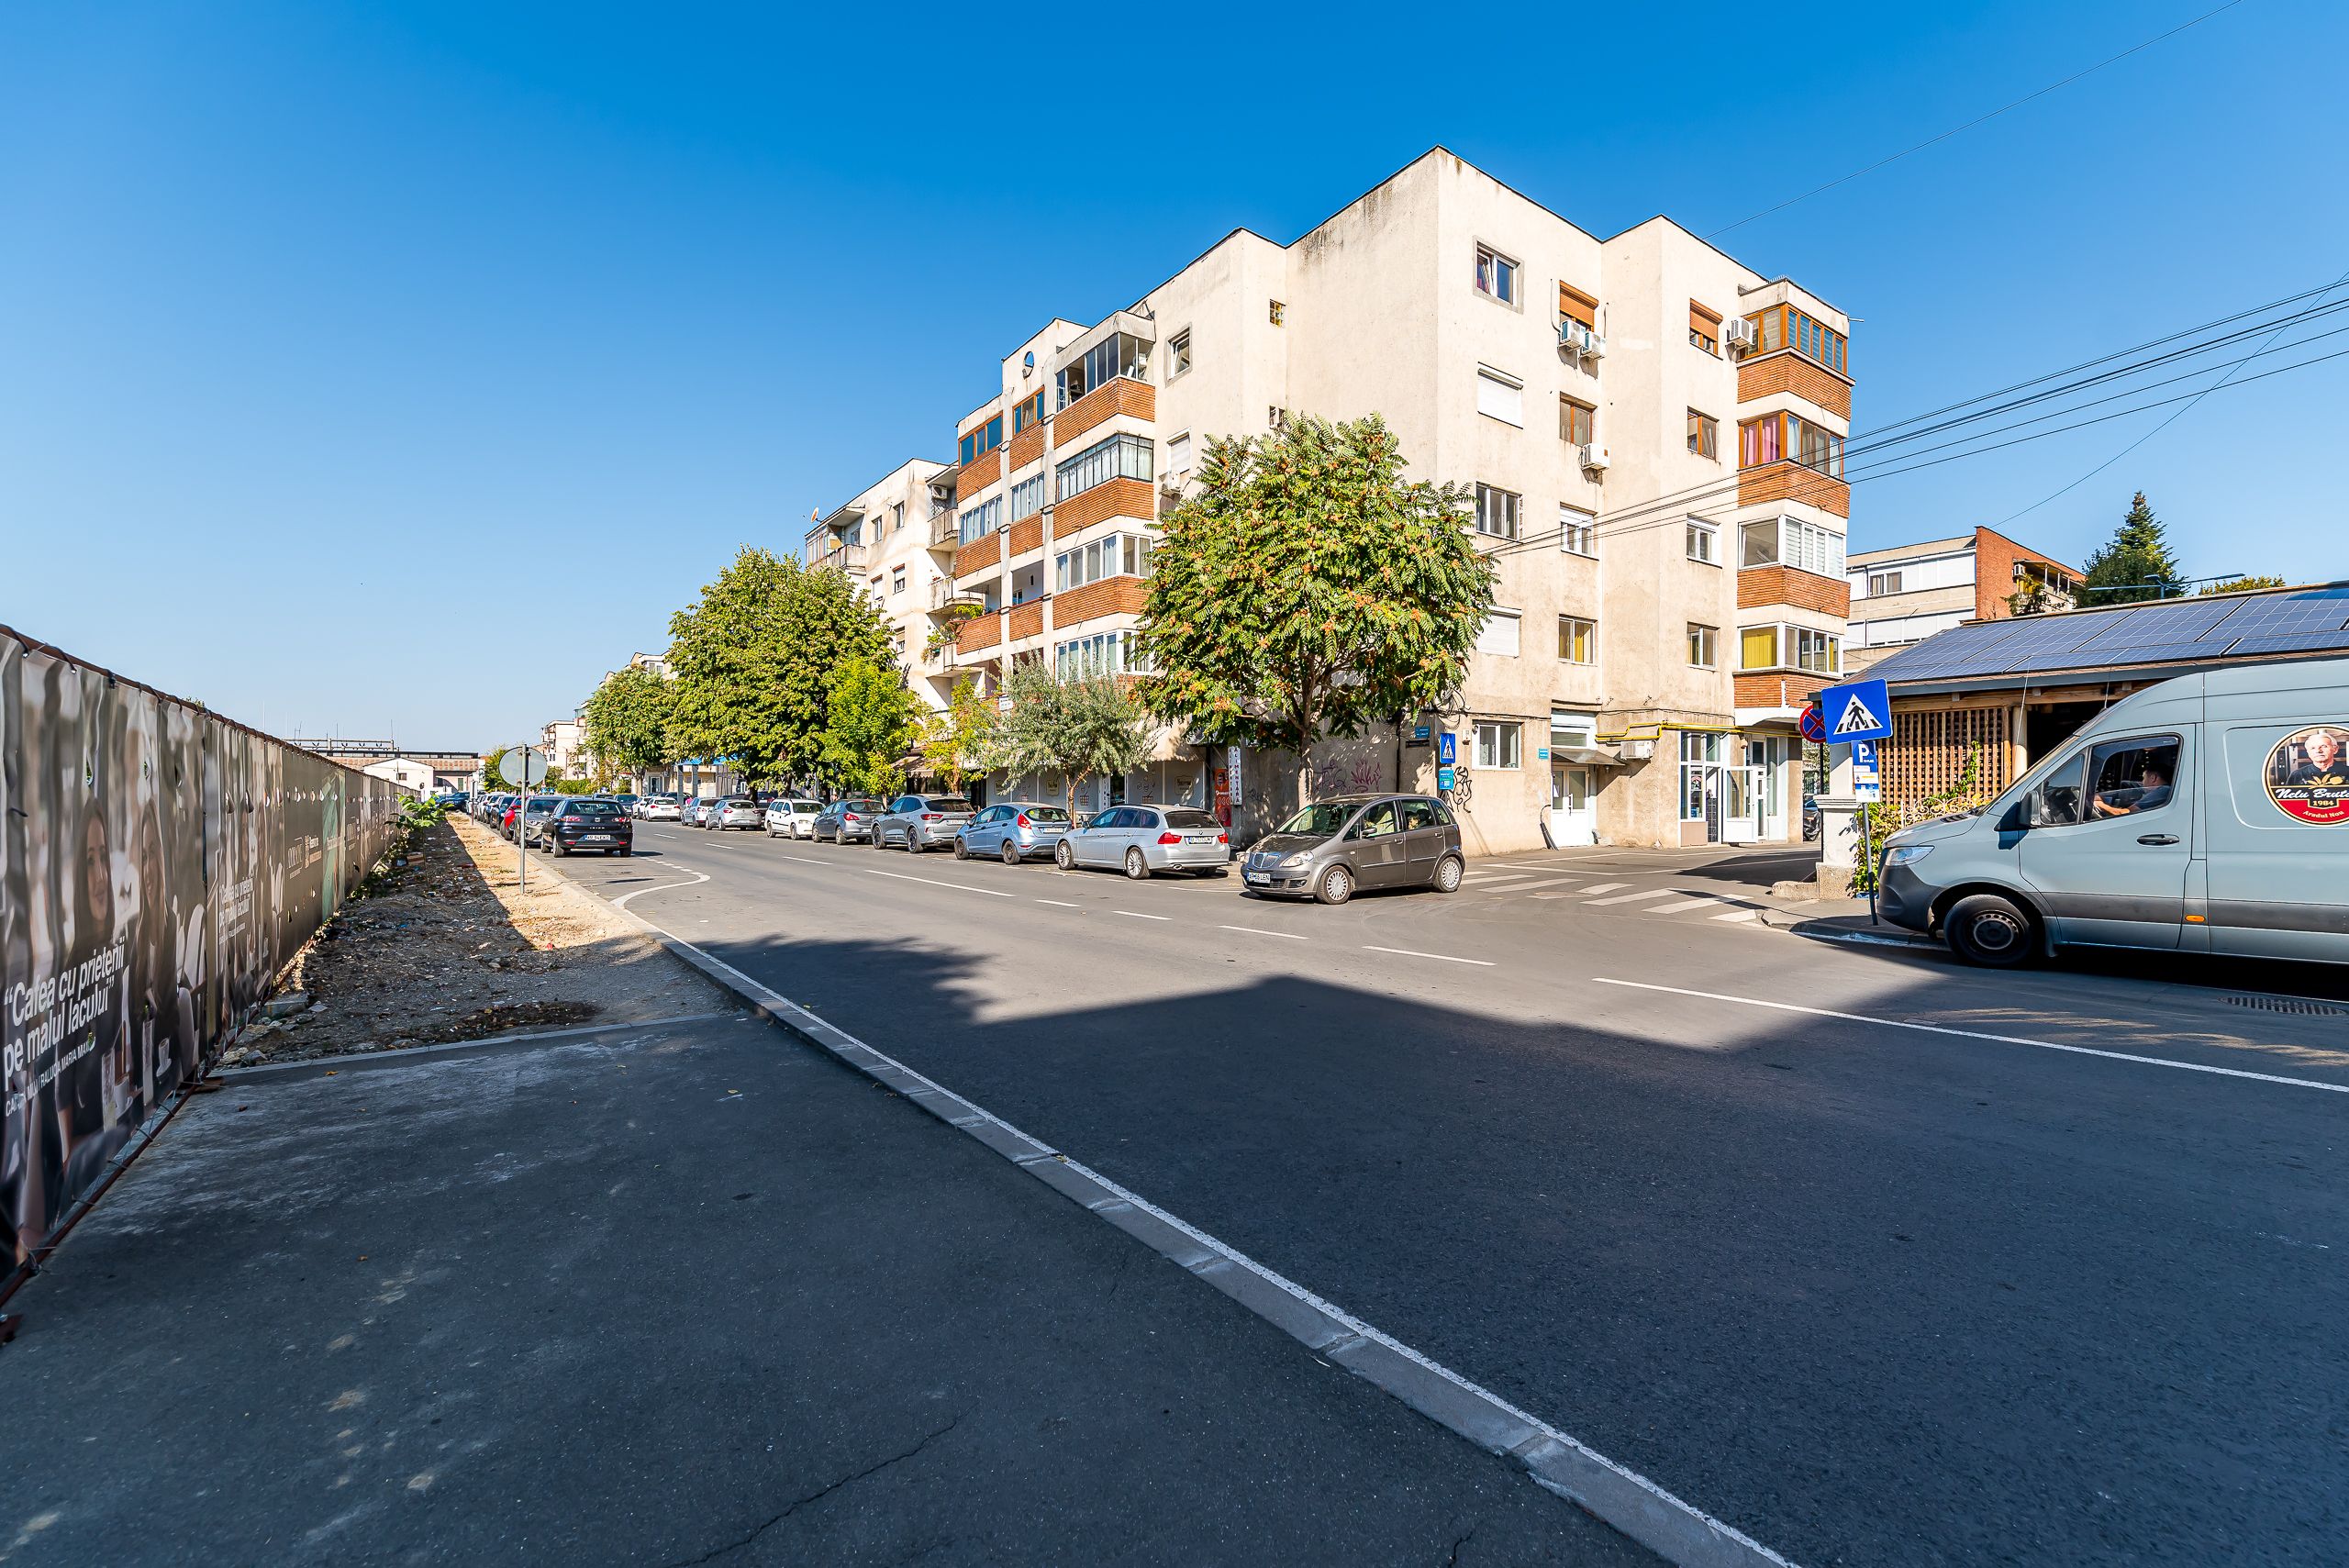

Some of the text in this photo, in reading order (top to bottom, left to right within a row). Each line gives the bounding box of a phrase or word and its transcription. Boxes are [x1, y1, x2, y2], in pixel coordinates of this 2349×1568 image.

[2276, 788, 2310, 799] Nelu
[2302, 810, 2328, 818] Aradul
[59, 967, 77, 1001] cu
[78, 936, 126, 1001] prietenii
[4, 1038, 24, 1092] pe
[27, 1002, 65, 1063] malul
